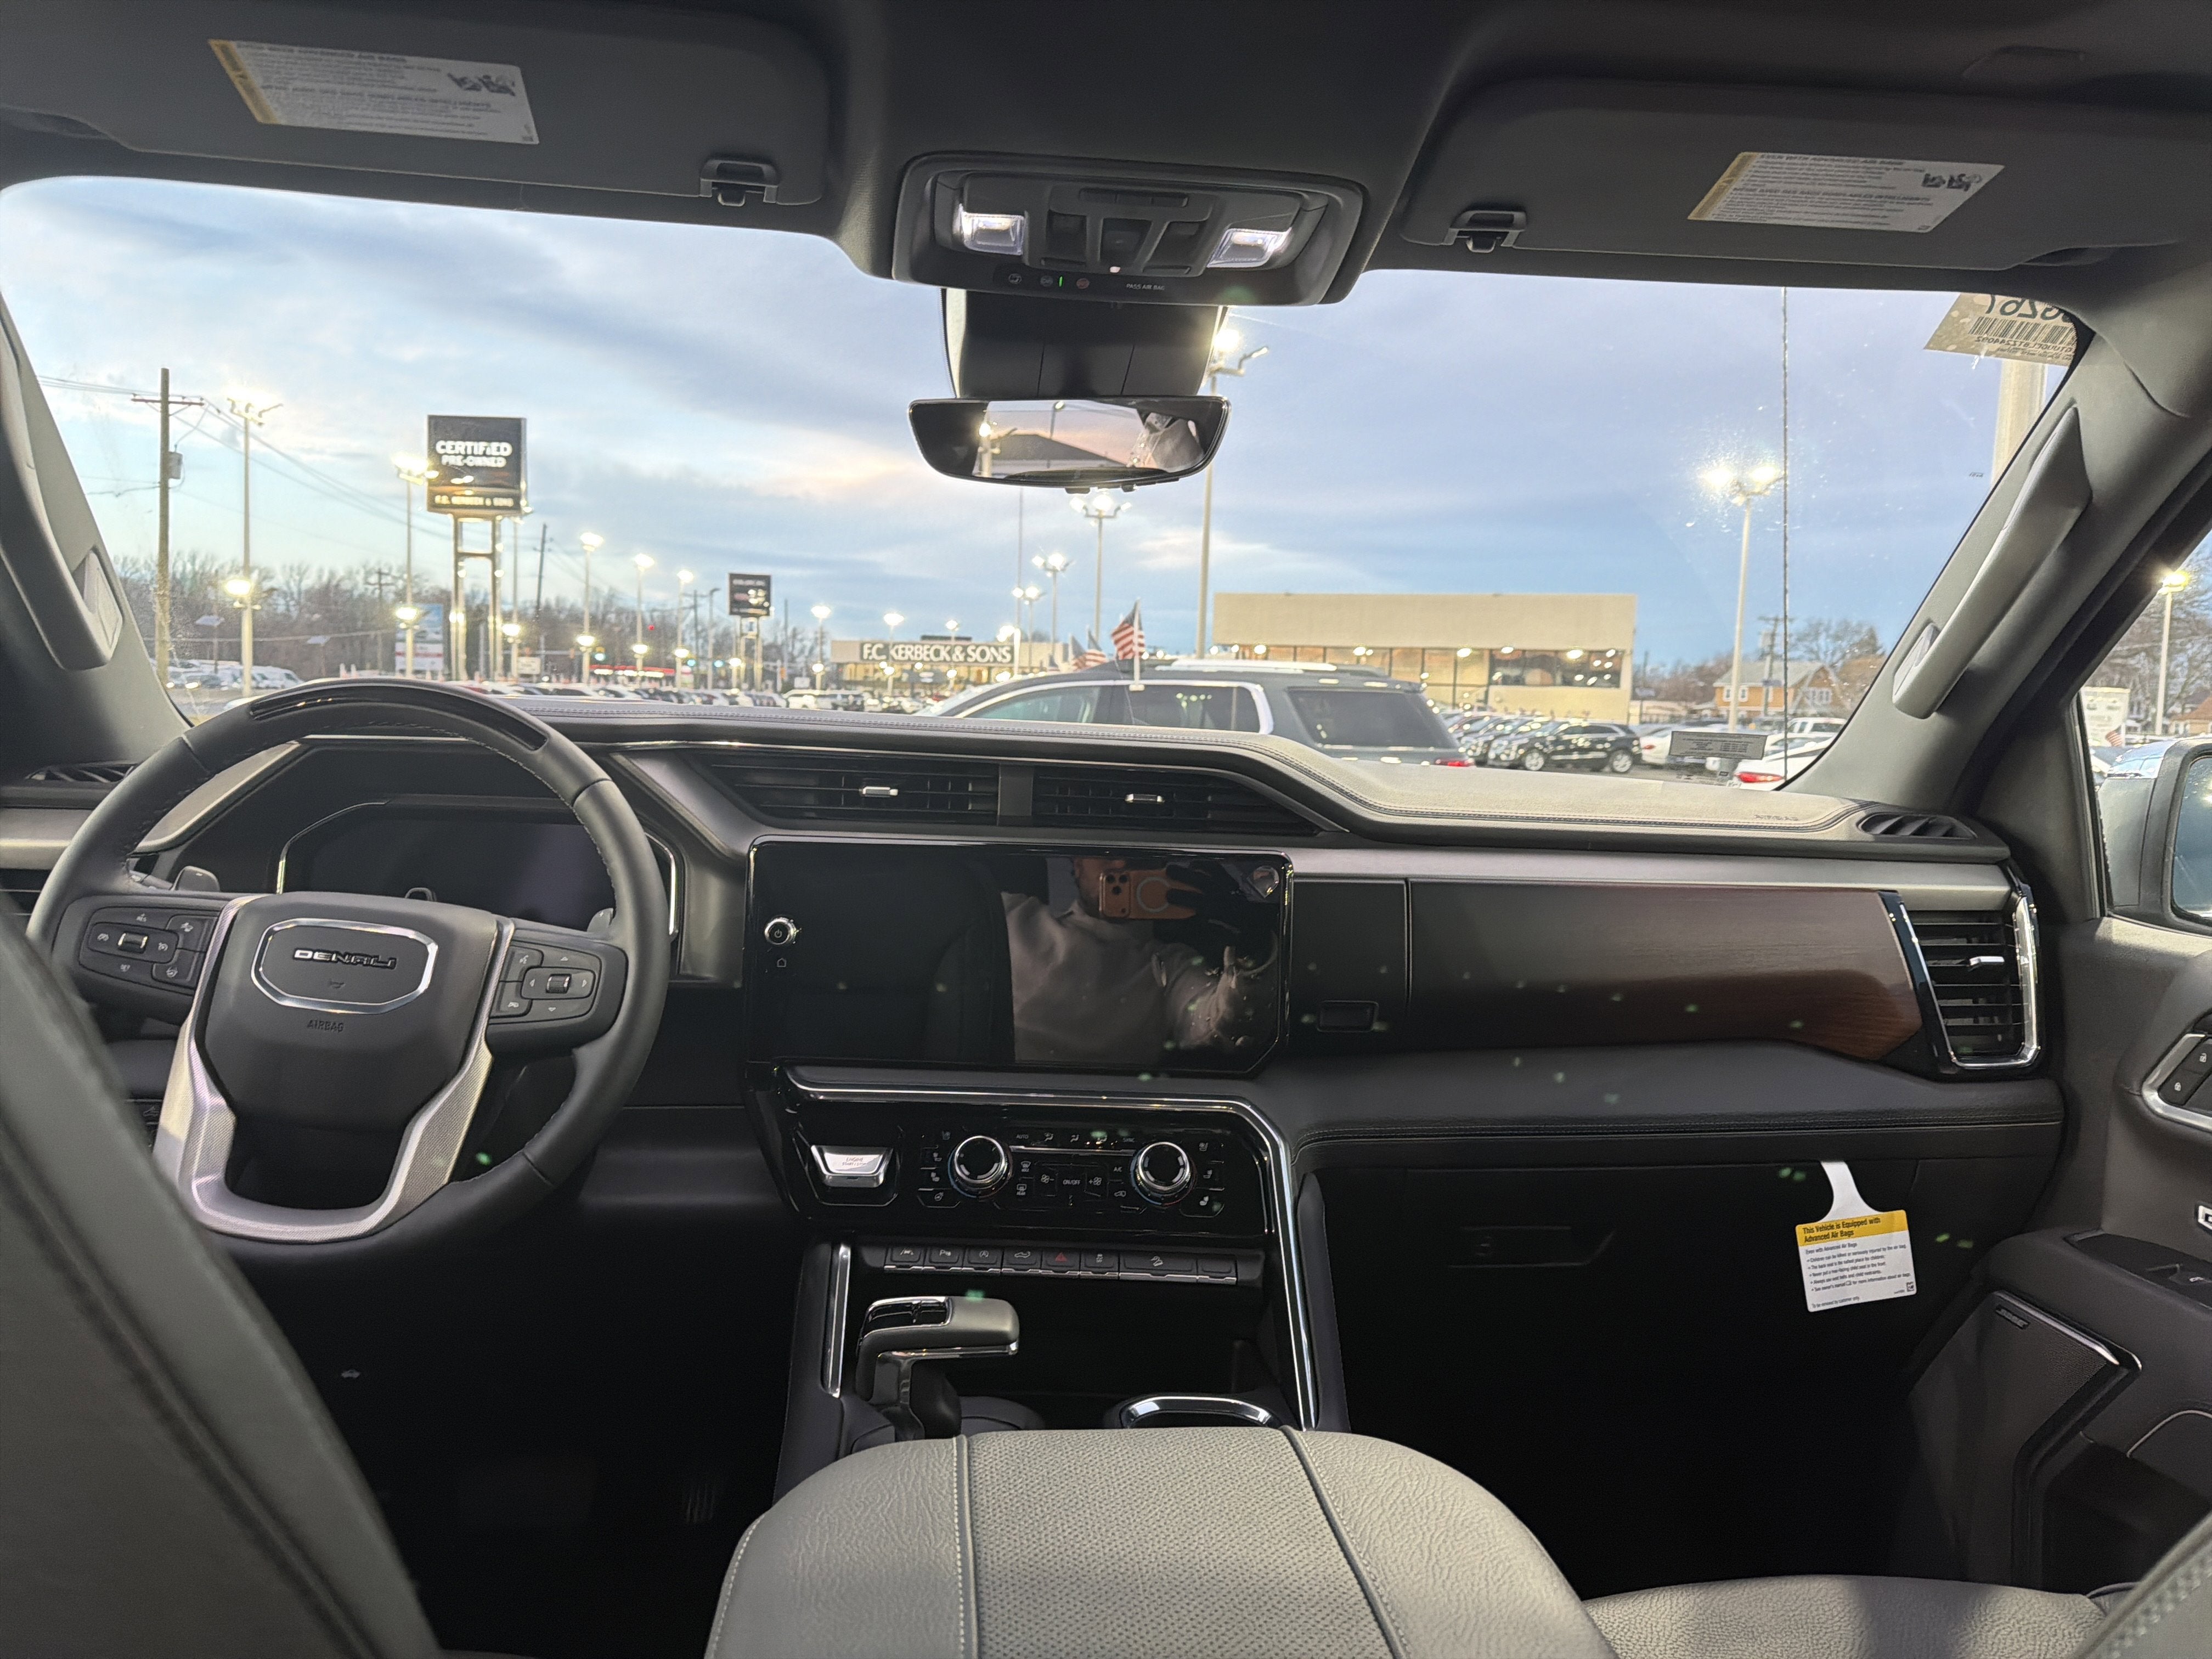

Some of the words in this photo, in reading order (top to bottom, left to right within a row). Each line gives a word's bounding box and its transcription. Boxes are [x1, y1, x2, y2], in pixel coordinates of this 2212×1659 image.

[436, 441, 512, 456] CERTIFIED
[889, 644, 951, 662] KERBECK
[952, 646, 966, 662] &
[967, 645, 1012, 663] SONS
[294, 948, 397, 969] DENALI
[307, 1019, 344, 1032] AIRBAG
[1842, 1219, 1867, 1229] Equipped
[1804, 1233, 1830, 1243] Advanced
[1840, 1229, 1854, 1238] Bags
